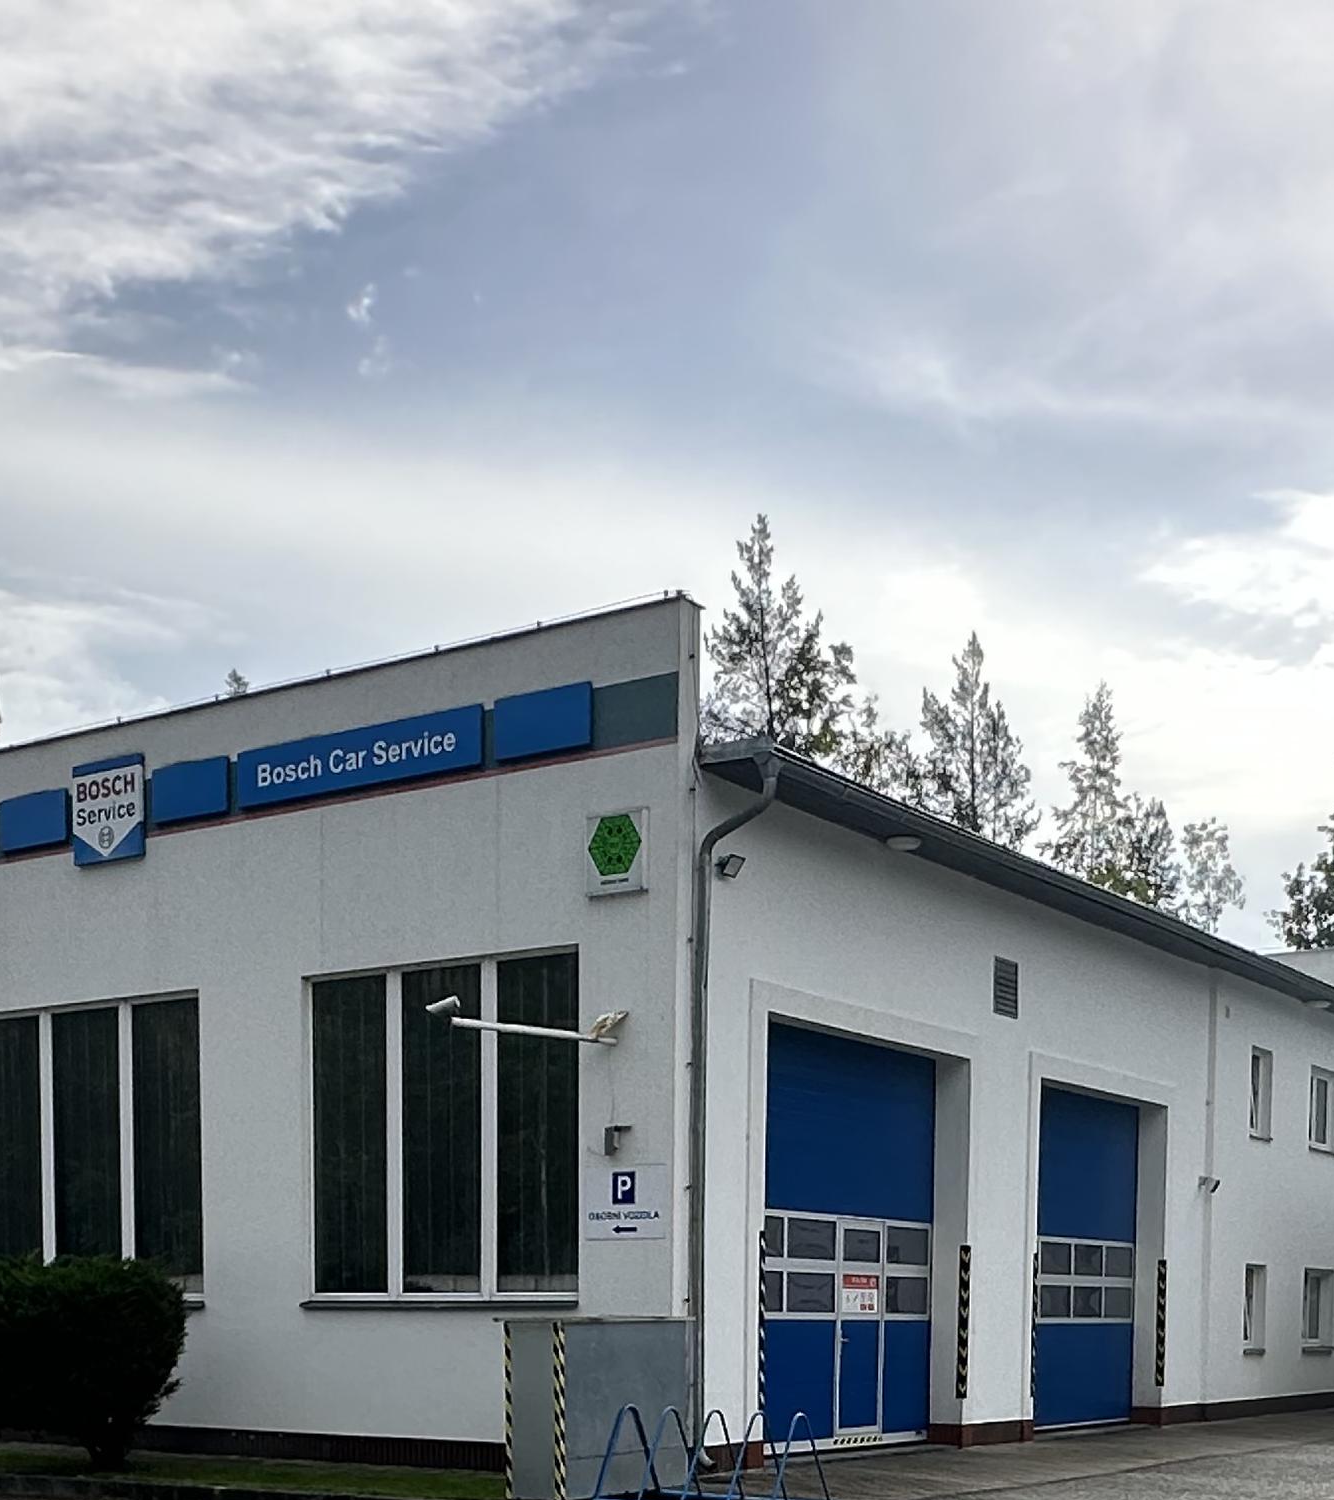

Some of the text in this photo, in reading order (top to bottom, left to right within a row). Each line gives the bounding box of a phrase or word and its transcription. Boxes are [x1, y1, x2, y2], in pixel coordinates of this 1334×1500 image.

[257, 731, 456, 787] Bosch Car Service
[77, 772, 135, 803] BOSCH
[76, 801, 135, 826] Service
[617, 1175, 632, 1199] P
